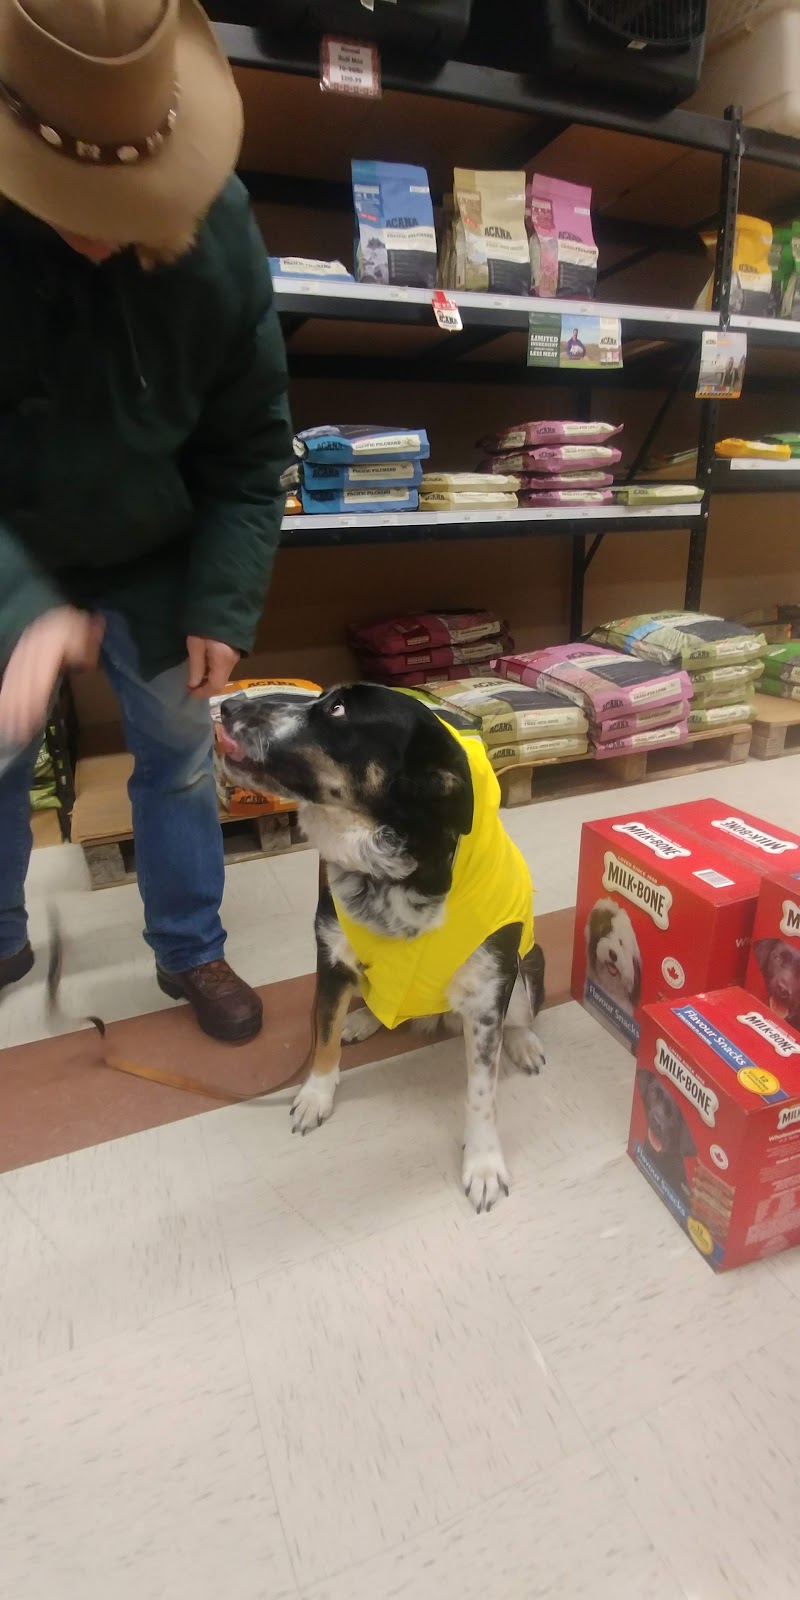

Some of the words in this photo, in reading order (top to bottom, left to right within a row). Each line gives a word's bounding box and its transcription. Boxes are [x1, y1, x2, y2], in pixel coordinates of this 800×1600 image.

[386, 217, 419, 229] ACANA
[484, 226, 512, 240] ACANA
[530, 334, 559, 343] LIMITED
[316, 440, 345, 451] ACANA
[602, 699, 624, 712] ACANA
[489, 722, 513, 733] ACANA
[492, 748, 516, 760] ACANA
[239, 794, 269, 804] ACANA
[589, 985, 614, 1014] Flavour
[614, 1009, 640, 1039] Snacks
[684, 1009, 717, 1037] Flavour
[713, 1036, 747, 1066] Snacks
[637, 1145, 661, 1182] Flavour
[661, 1179, 686, 1217] Snacks
